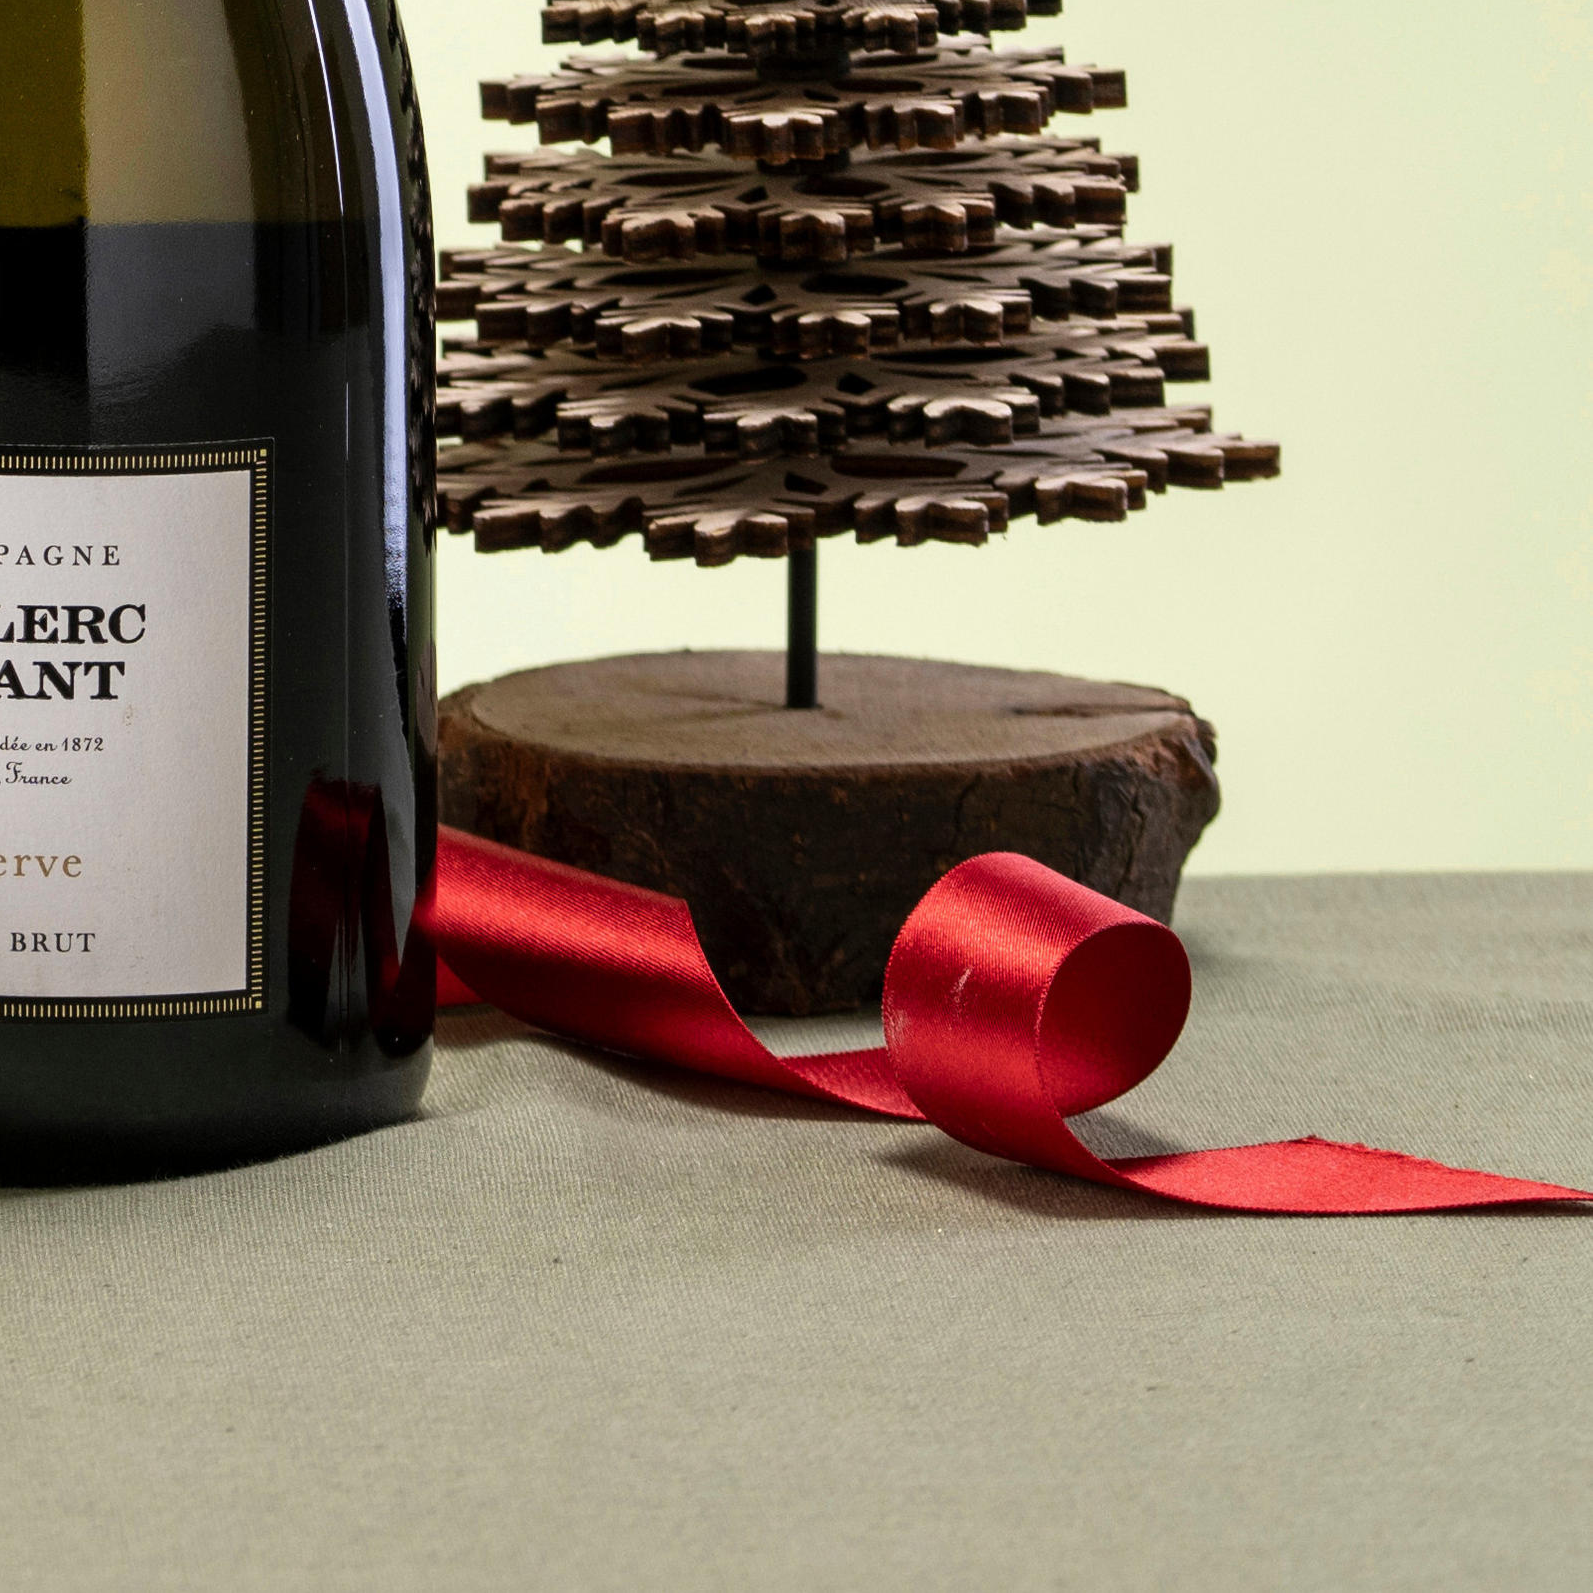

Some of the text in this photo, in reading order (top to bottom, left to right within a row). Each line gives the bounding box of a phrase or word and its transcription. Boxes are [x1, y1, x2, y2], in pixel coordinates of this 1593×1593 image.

[34, 742, 57, 753] en
[62, 736, 104, 752] 1872
[5, 761, 72, 786] France
[10, 932, 97, 953] BRUT
